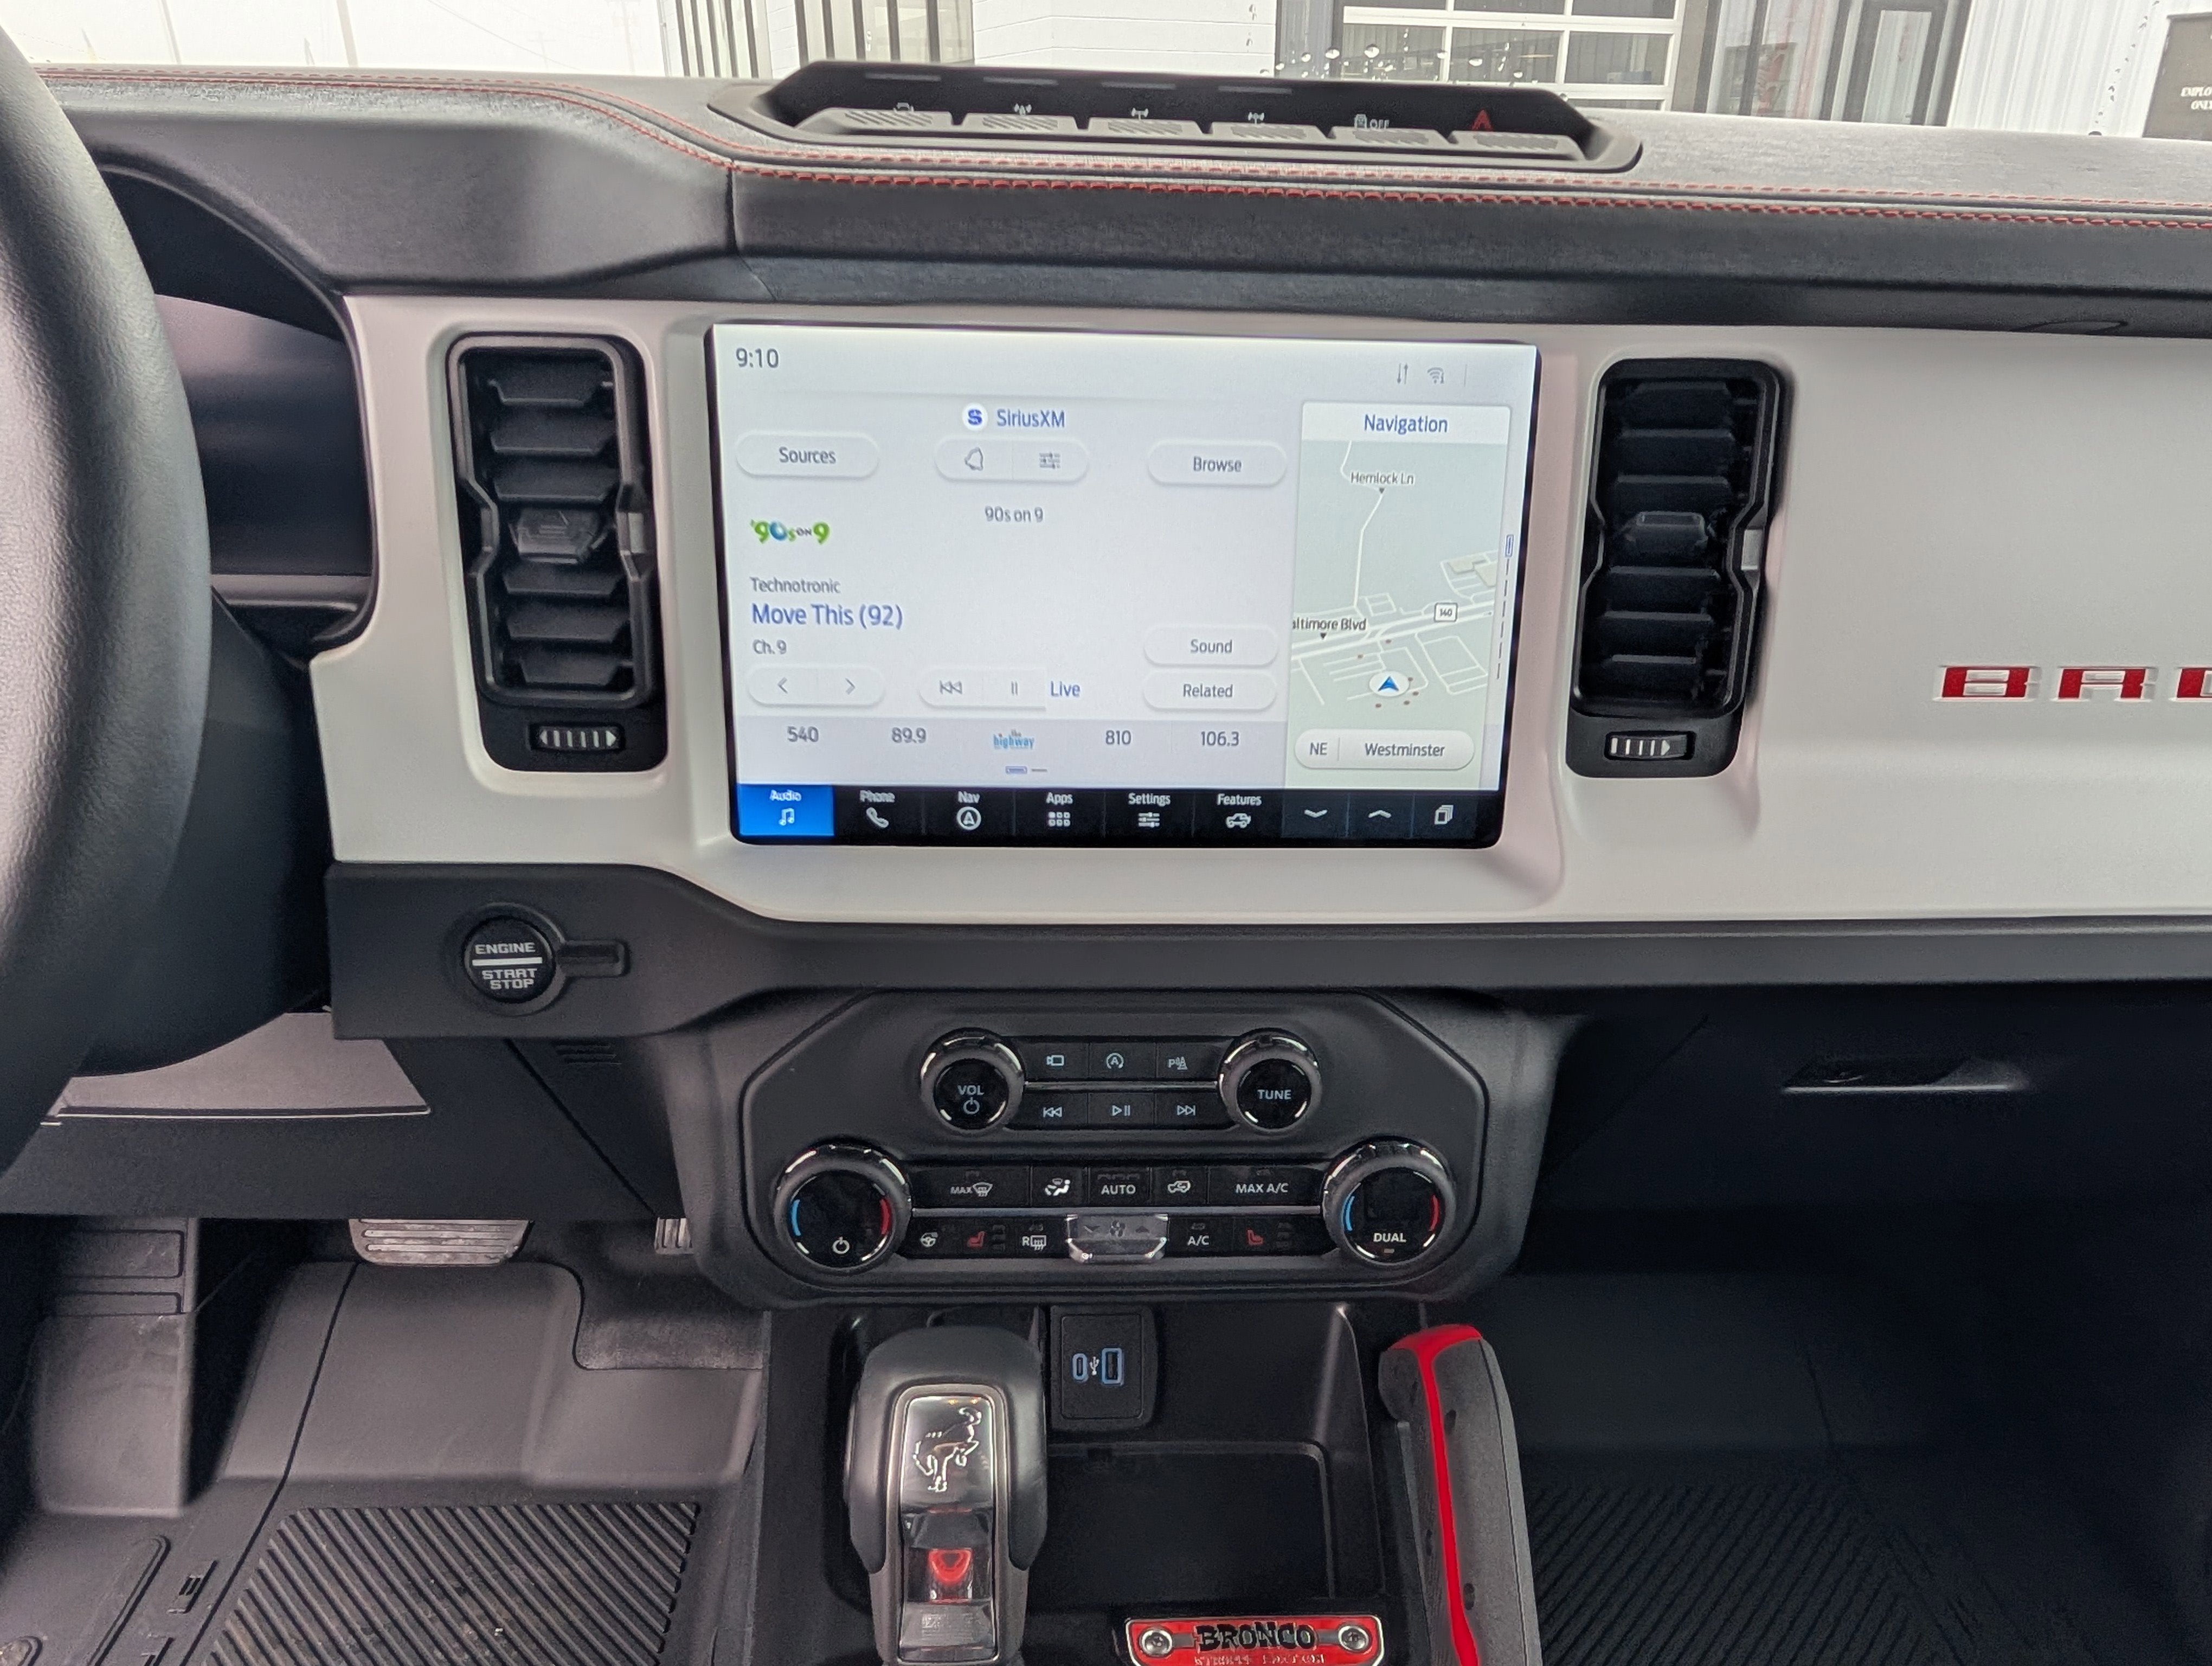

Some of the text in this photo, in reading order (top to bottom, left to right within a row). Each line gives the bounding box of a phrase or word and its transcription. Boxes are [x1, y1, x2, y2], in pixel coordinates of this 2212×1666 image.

[735, 348, 780, 368] 9:10
[996, 408, 1065, 428] SiriusXM
[1364, 414, 1449, 435] Navigation
[779, 446, 837, 464] Sources
[1193, 456, 1242, 472] Browse
[1350, 471, 1414, 485] Hemlock Ln
[985, 505, 1044, 523] 90s on 9
[813, 522, 831, 545] 9
[750, 577, 841, 594] Technotronic
[751, 603, 904, 630] Move This (92)
[1438, 608, 1454, 618] 140
[1341, 618, 1367, 631] Blvd
[752, 639, 787, 655] Ch. 9
[1190, 639, 1233, 653] Sound
[1050, 681, 1081, 698] Live
[1182, 683, 1233, 698] Related
[787, 726, 819, 743] 540
[891, 727, 927, 744] 89.9
[993, 733, 1034, 750] highway
[1105, 730, 1132, 745] 810
[1200, 731, 1240, 746] 106.3
[1309, 742, 1445, 758] NE Westminster
[769, 789, 802, 802] Audio
[859, 790, 895, 803] Phone
[957, 791, 980, 804] Nav
[1045, 792, 1073, 805] Apps
[1128, 792, 1171, 807] Settings
[1217, 793, 1262, 806] Features
[474, 942, 536, 955] ENGINE
[481, 968, 538, 980] START
[490, 979, 535, 990] STOP
[957, 1085, 985, 1095] VOL
[1257, 1089, 1291, 1100] TUNE
[950, 1186, 973, 1194] MAX
[1101, 1184, 1136, 1195] AUTO
[1236, 1182, 1289, 1194] MAX A/C
[1187, 1235, 1210, 1247] A/C
[1373, 1232, 1407, 1243] DUAL
[1193, 1622, 1318, 1652] BRONCO
